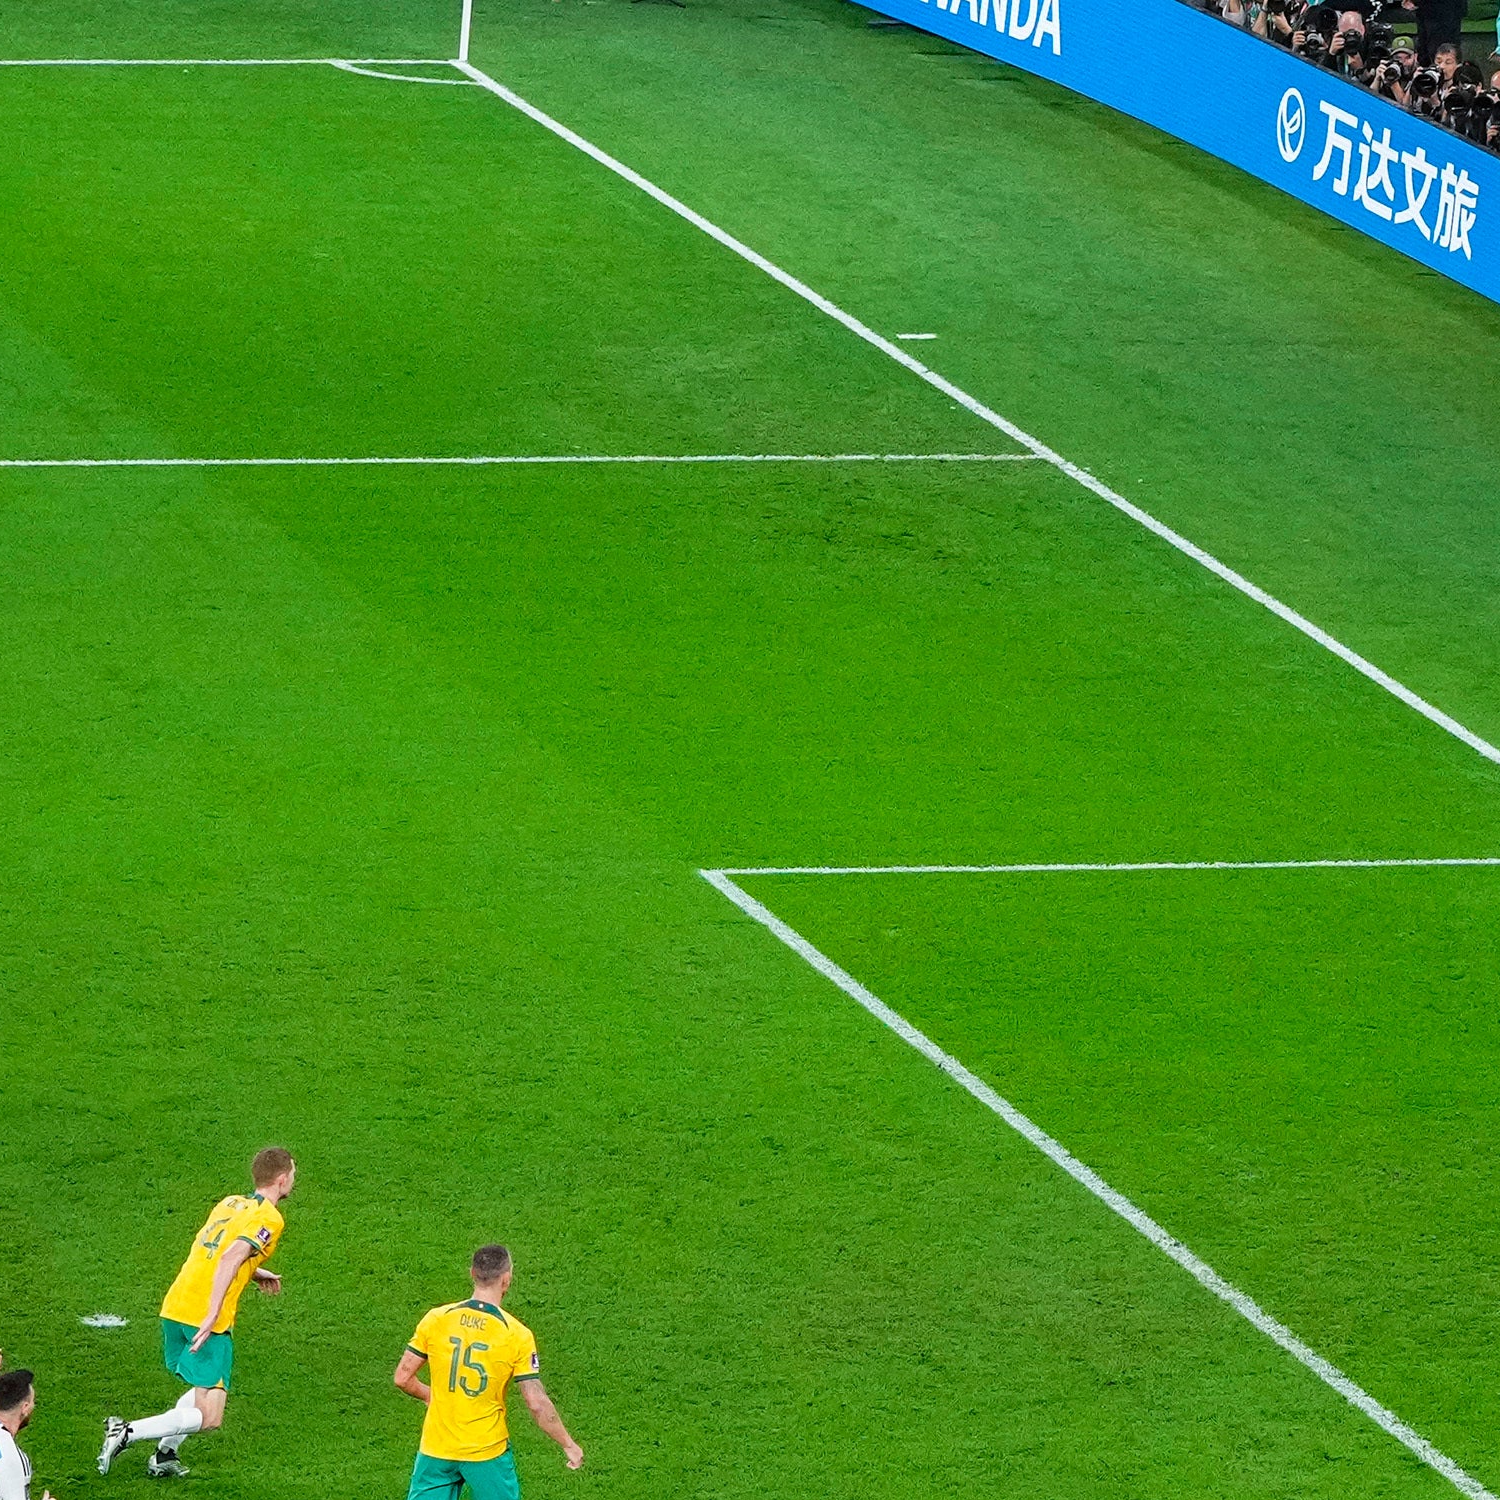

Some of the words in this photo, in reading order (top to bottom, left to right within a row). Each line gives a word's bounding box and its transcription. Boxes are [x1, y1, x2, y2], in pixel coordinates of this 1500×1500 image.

[1312, 100, 1480, 260] 万达文旅
[460, 1313, 488, 1331] DUKE
[448, 1335, 489, 1398] 15
